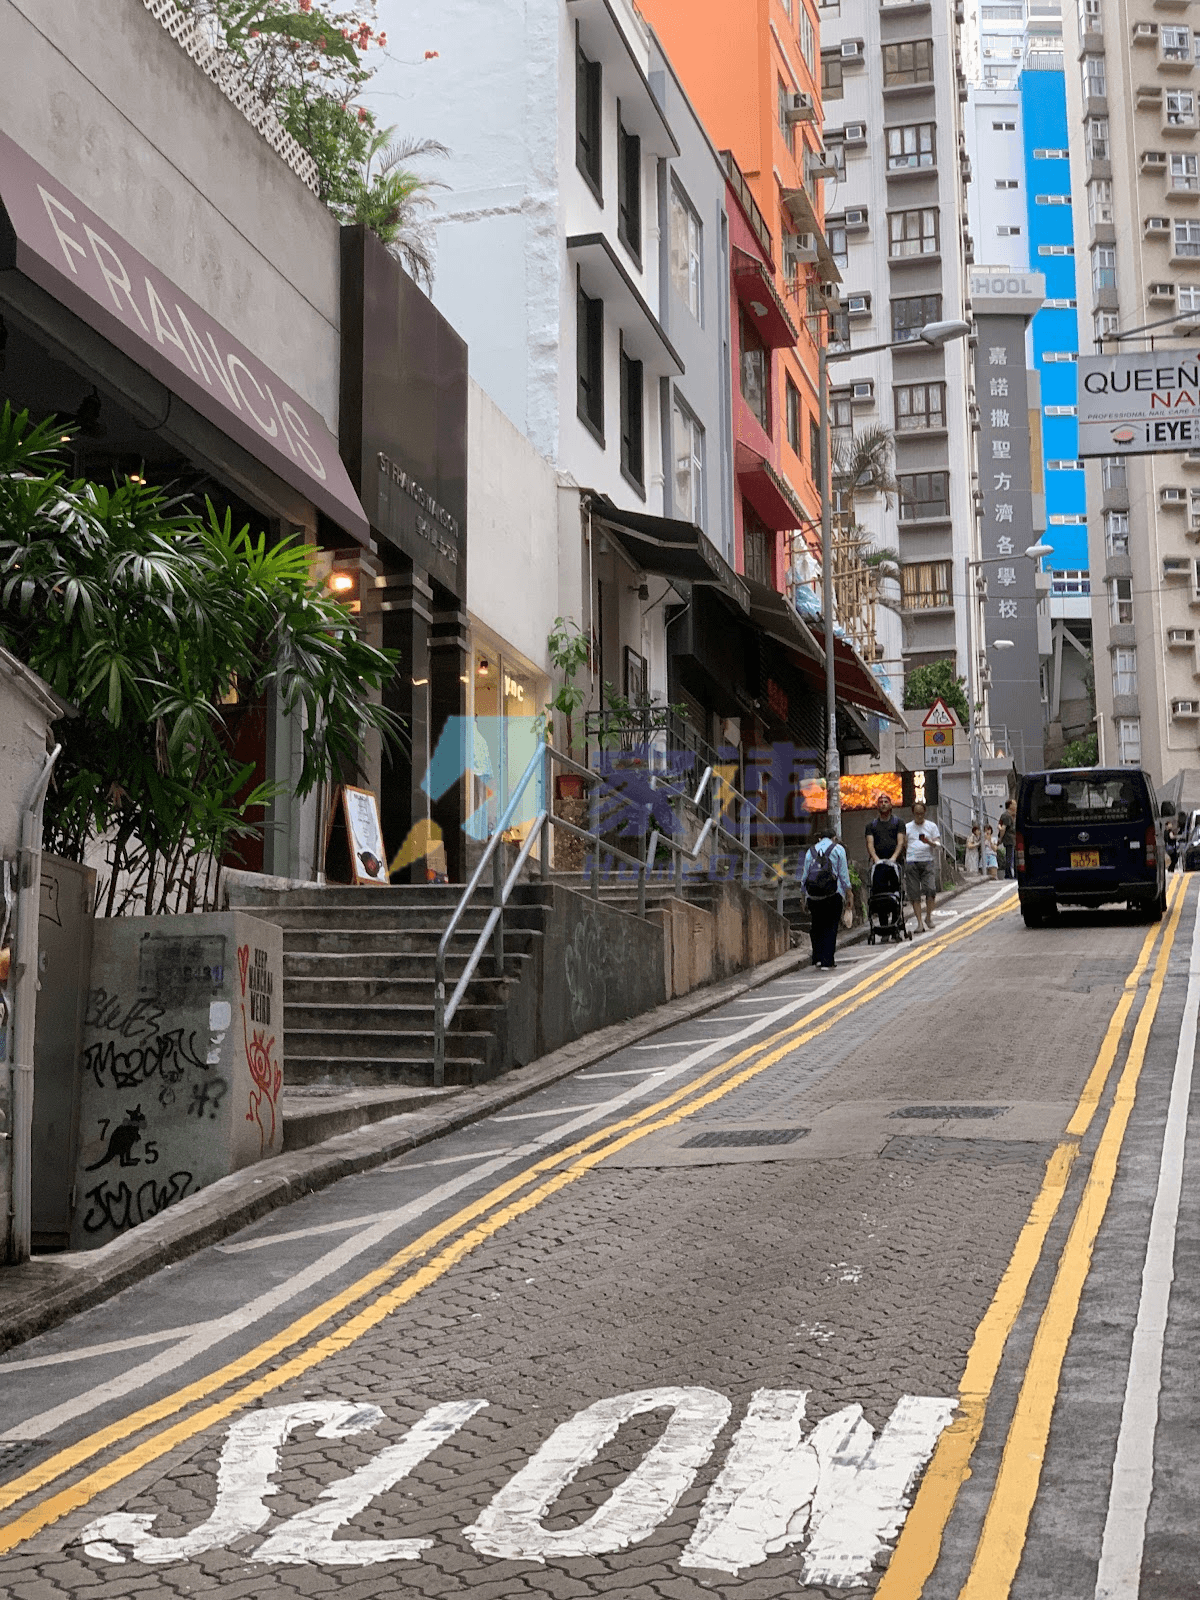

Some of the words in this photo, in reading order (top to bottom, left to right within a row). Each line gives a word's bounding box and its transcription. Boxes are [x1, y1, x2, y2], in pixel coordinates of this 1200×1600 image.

[970, 278, 1032, 295] HOOL
[37, 184, 327, 481] FRANCIS
[1151, 390, 1200, 409] NA
[1087, 412, 1146, 420] PROFESSIONAL
[1154, 421, 1192, 442] EYE
[988, 346, 1018, 620] 嘉諾撒聖方濟各學校
[145, 1141, 159, 1164] 5
[81, 1386, 960, 1589] SLOW
